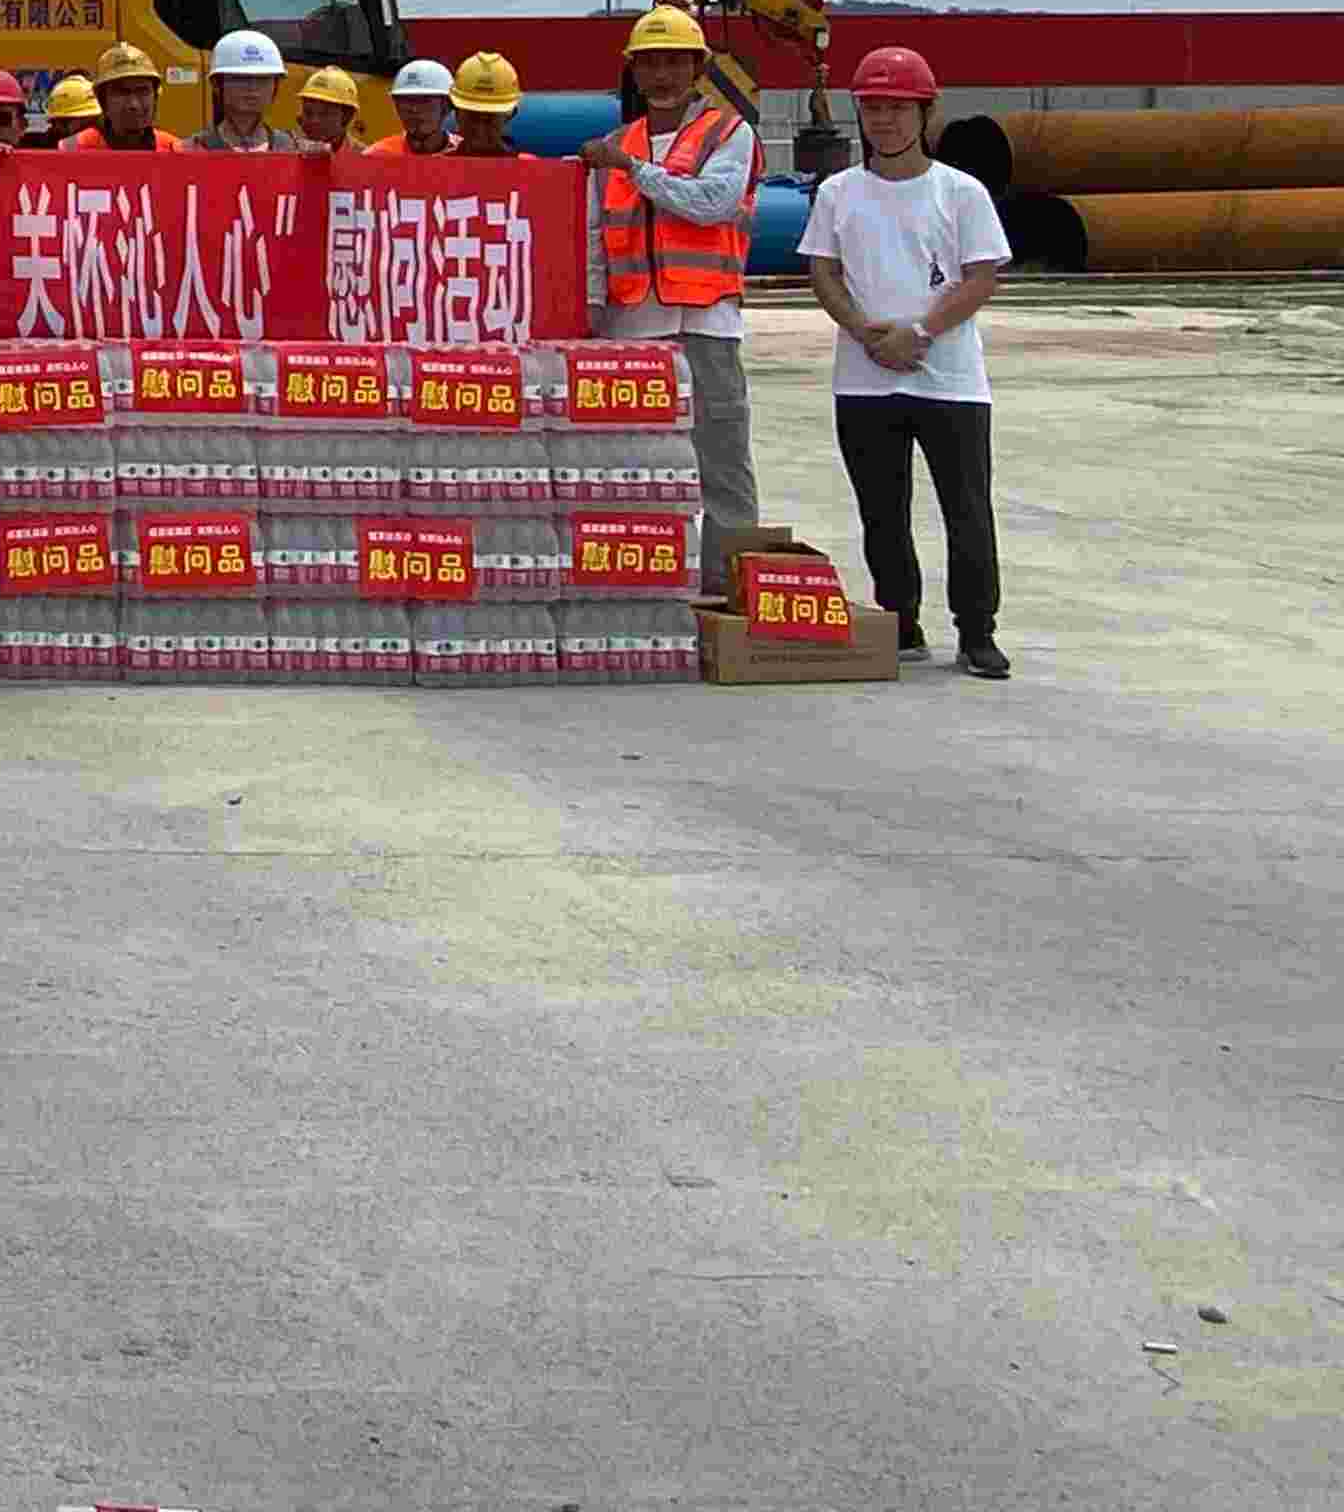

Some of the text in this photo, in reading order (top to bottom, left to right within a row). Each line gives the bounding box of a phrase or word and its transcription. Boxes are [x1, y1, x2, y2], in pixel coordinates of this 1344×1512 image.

[326, 188, 533, 344] 慰问活动
[141, 369, 237, 399] 慰问品
[288, 373, 382, 404] 慰问品
[421, 381, 517, 413] 慰问品
[576, 377, 670, 409] 慰问品
[7, 545, 104, 577] 慰问品
[149, 543, 245, 575] 慰问品
[368, 550, 466, 582] 慰问品
[582, 543, 679, 574] 慰问品
[758, 592, 849, 624] 慰问品
